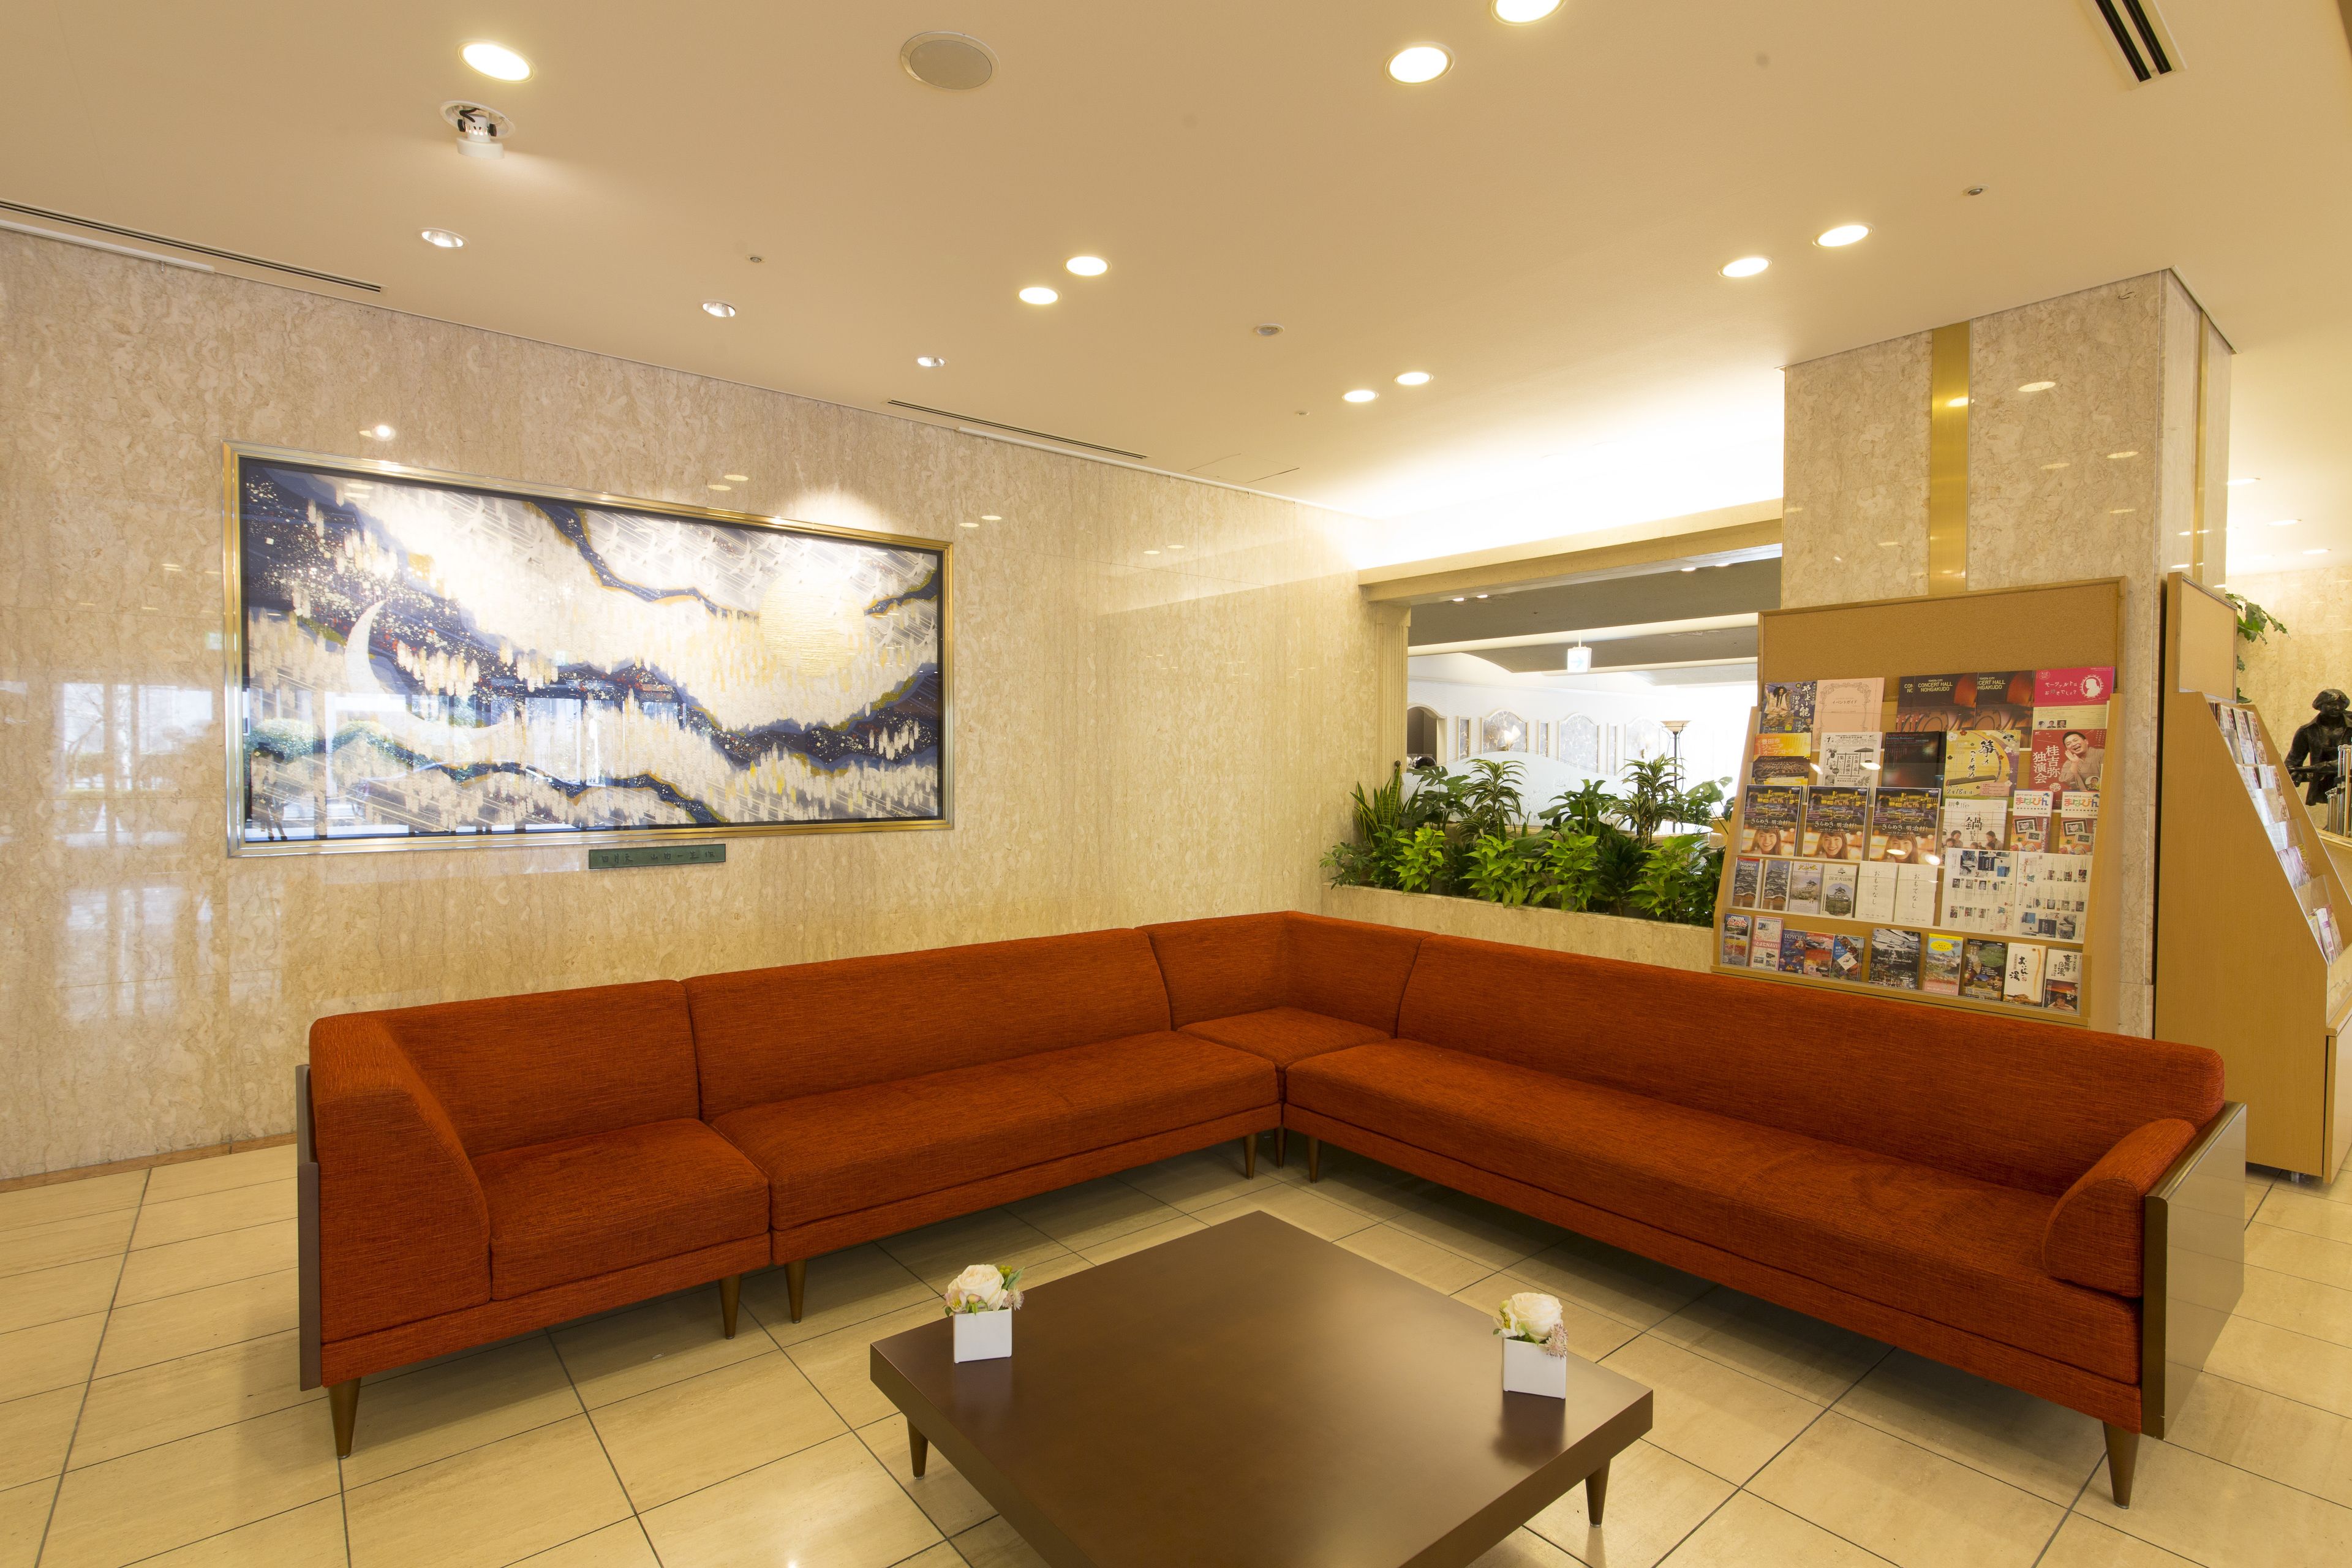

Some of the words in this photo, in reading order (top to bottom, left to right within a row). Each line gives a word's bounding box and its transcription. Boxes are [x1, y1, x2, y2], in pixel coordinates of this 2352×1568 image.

[2032, 751, 2048, 784] 独演会
[2045, 745, 2061, 778] 桂吉弥
[1912, 873, 1920, 908] おもてなし
